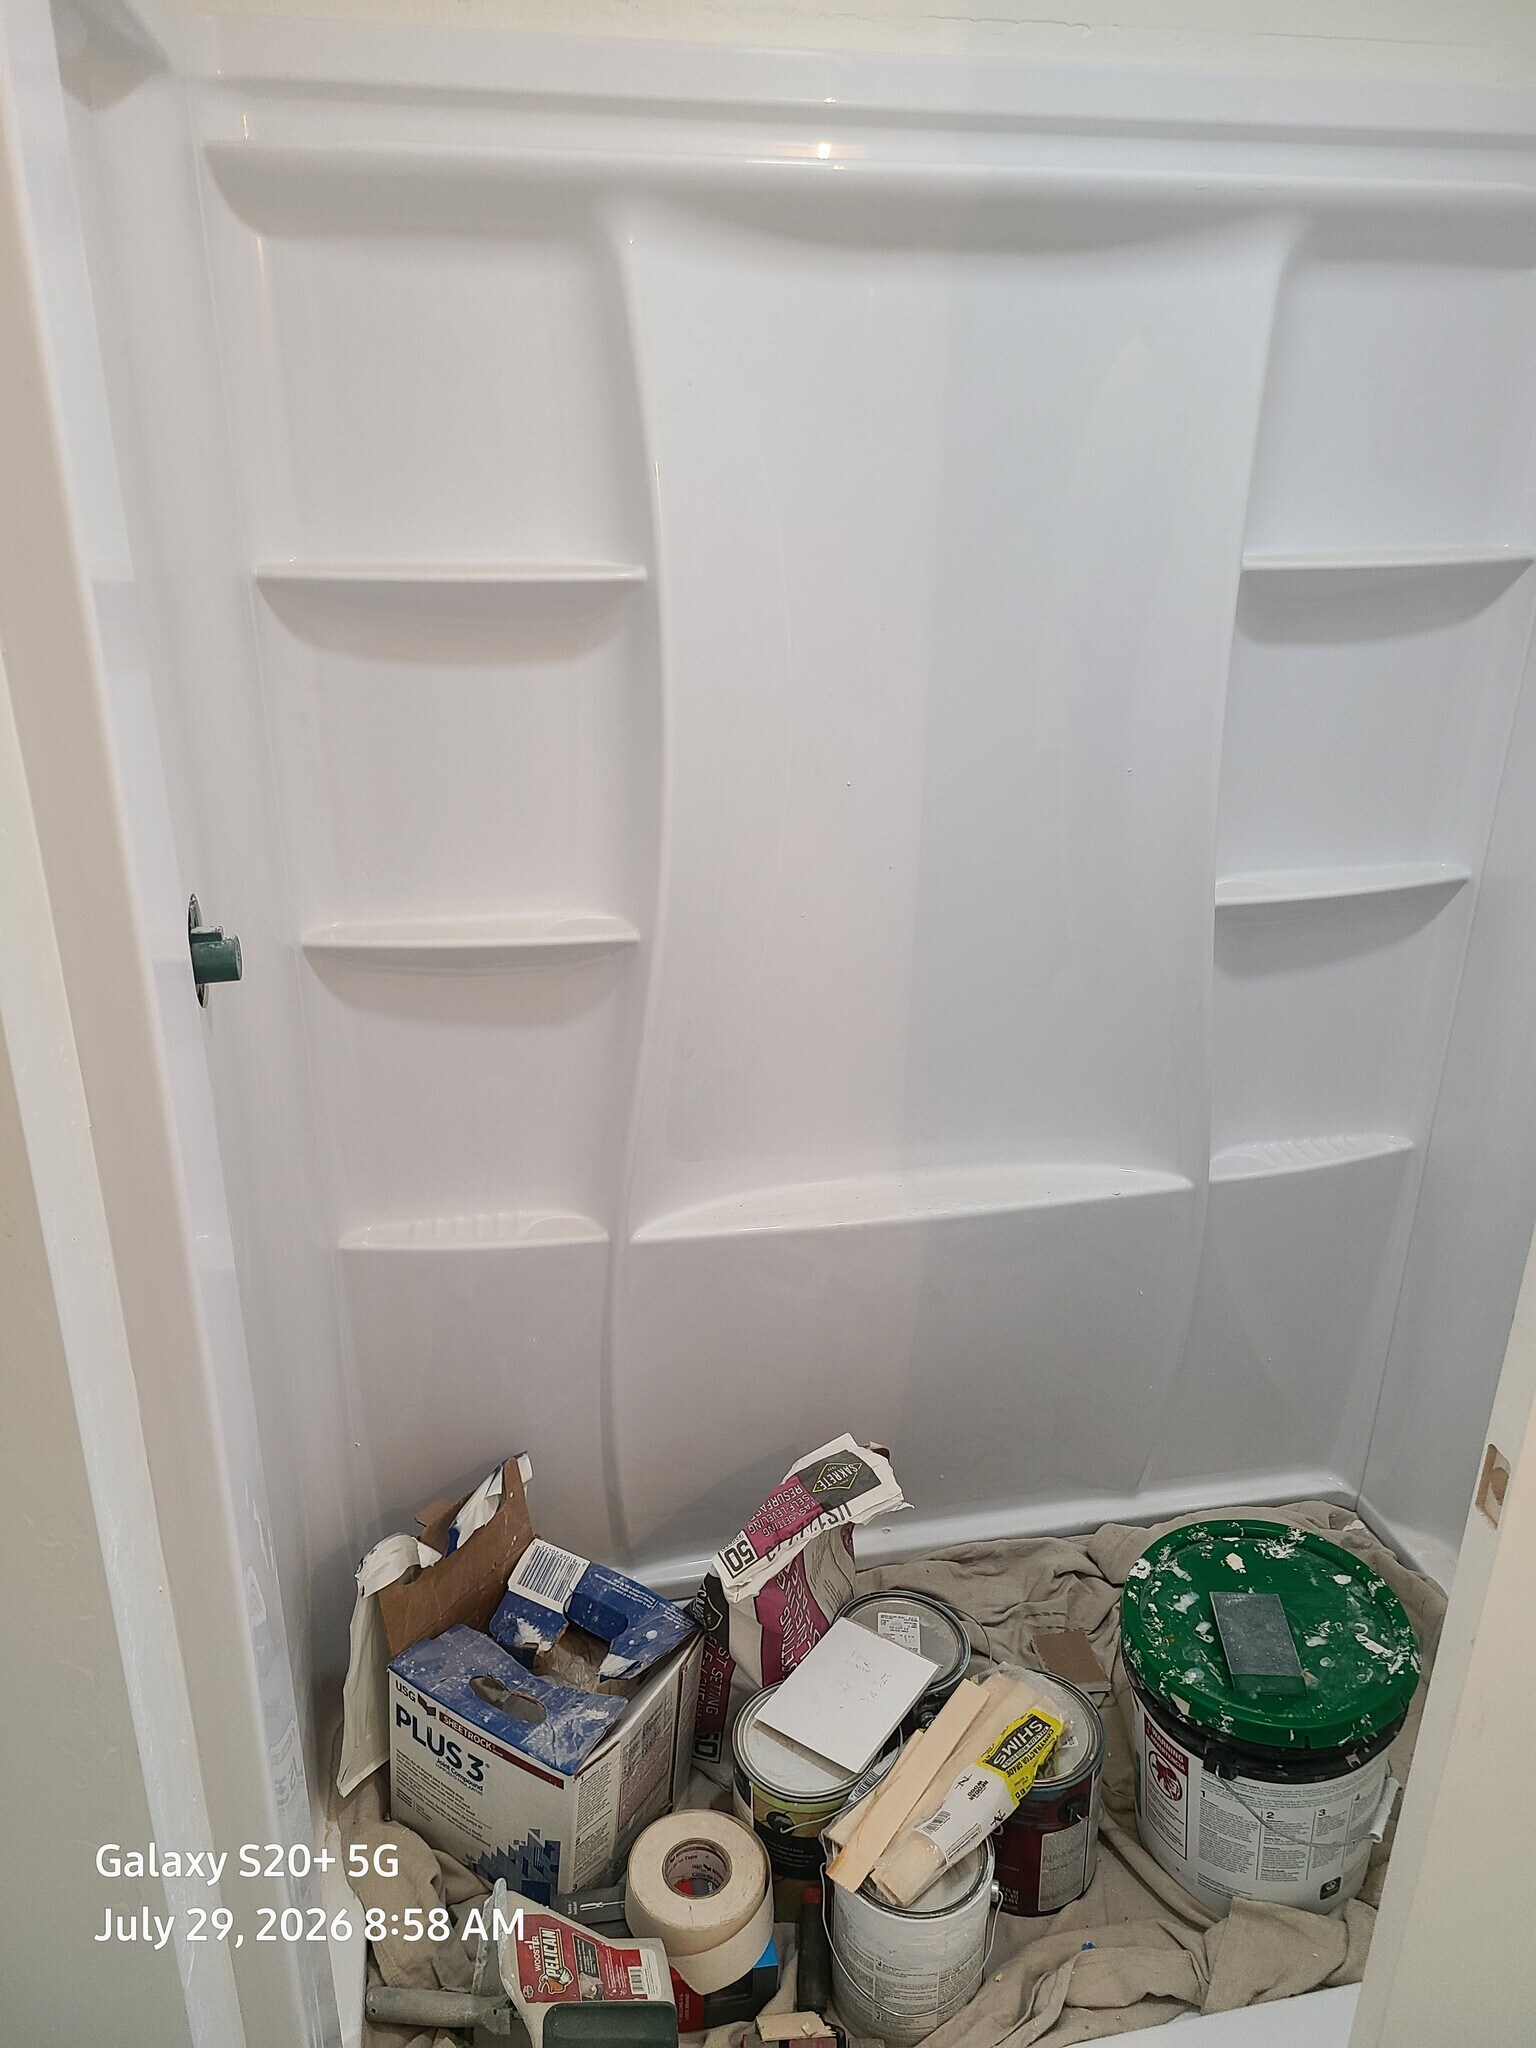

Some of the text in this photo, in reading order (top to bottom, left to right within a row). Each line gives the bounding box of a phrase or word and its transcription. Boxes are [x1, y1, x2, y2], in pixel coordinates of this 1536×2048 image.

[816, 1463, 858, 1491] SAKRETE
[749, 1494, 810, 1535] SELF-LEVELING
[763, 1515, 796, 1537] SETTING
[725, 1540, 754, 1571] 50
[395, 1680, 416, 1703] USG
[706, 1667, 724, 1716] SETTING
[396, 1703, 484, 1782] PLUS 3
[443, 1715, 493, 1752] SHEETROCK
[993, 1720, 1043, 1766] SHIMS
[1022, 1728, 1055, 1766] CONTRACTOR
[1151, 1726, 1184, 1763] WARNING
[1006, 1761, 1023, 1779] GRADE
[1150, 1734, 1185, 1772] ADVERTENCIA
[1266, 1811, 1275, 1820] 2
[1318, 1809, 1326, 1817] 3
[532, 1935, 540, 1972] WOOSTER
[541, 1929, 560, 1978] PELICAN
